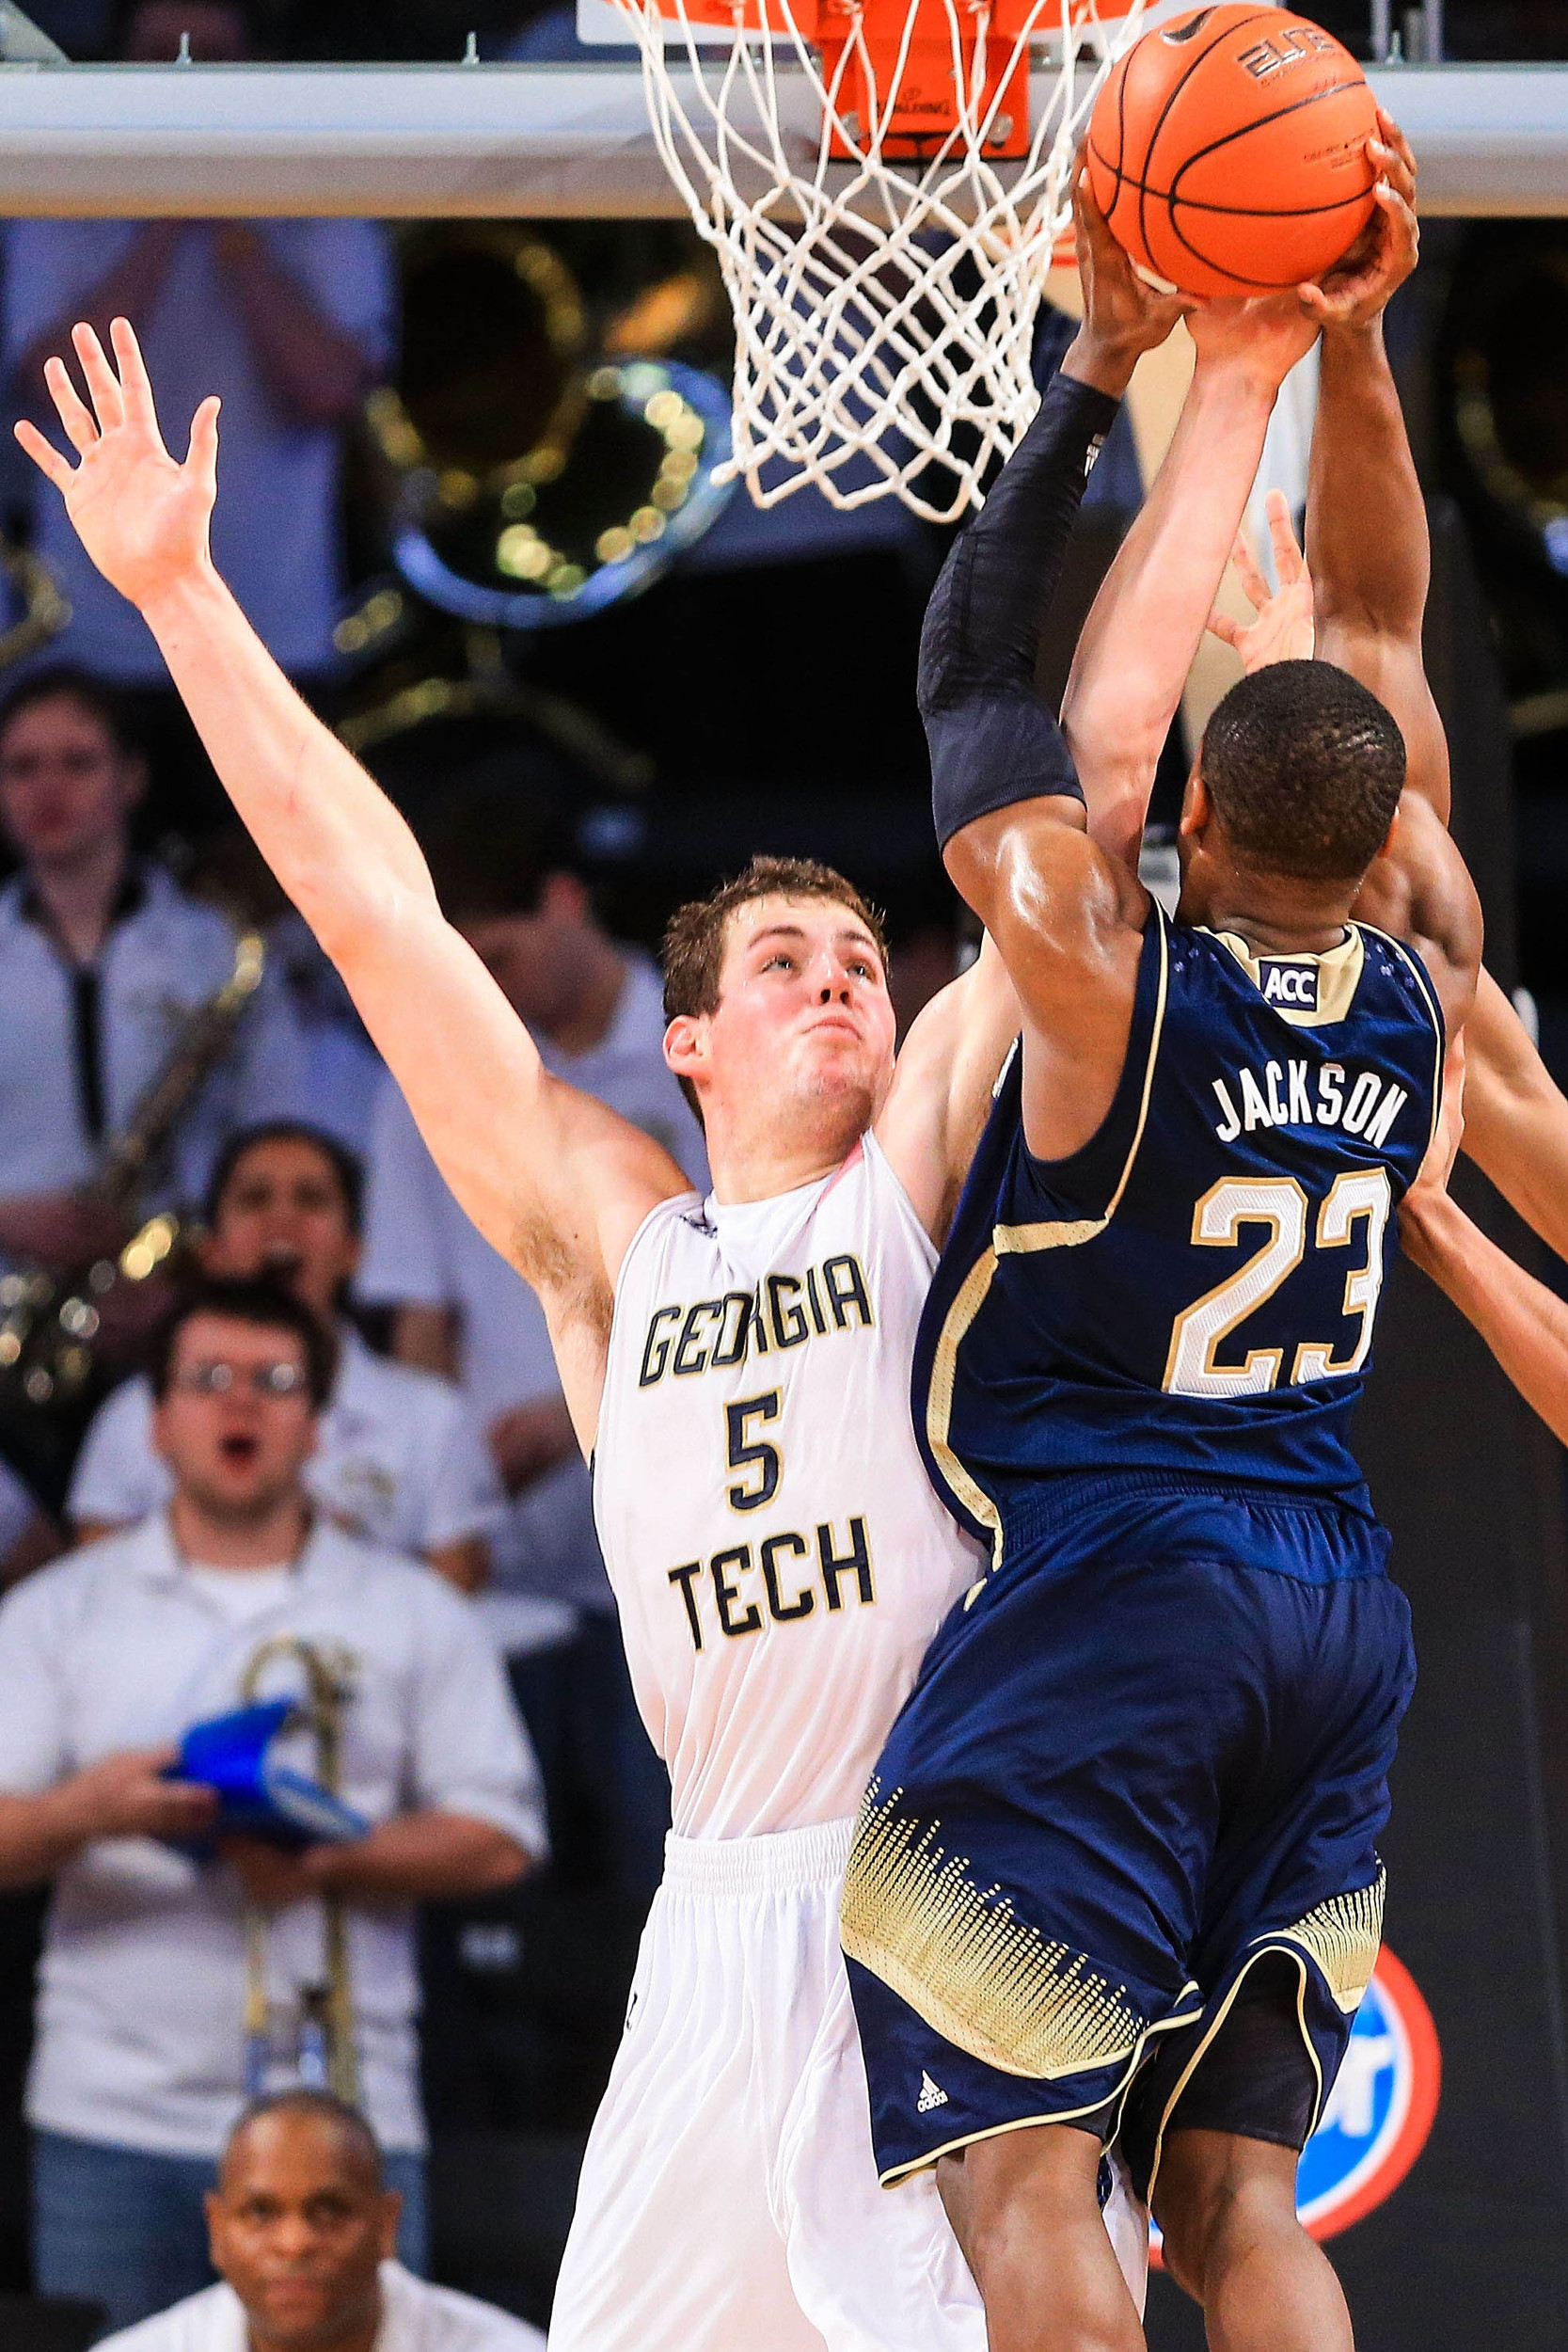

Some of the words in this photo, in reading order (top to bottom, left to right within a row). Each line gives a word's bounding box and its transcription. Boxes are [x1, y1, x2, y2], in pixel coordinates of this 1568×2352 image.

[1264, 967, 1316, 1004] ACC
[1212, 1059, 1408, 1149] JACKSON
[638, 1252, 875, 1391] GEORGIA
[1161, 1167, 1391, 1398] 23
[723, 1387, 783, 1515] 5
[666, 1516, 875, 1652] TECH
[917, 2090, 949, 2113] adidas
